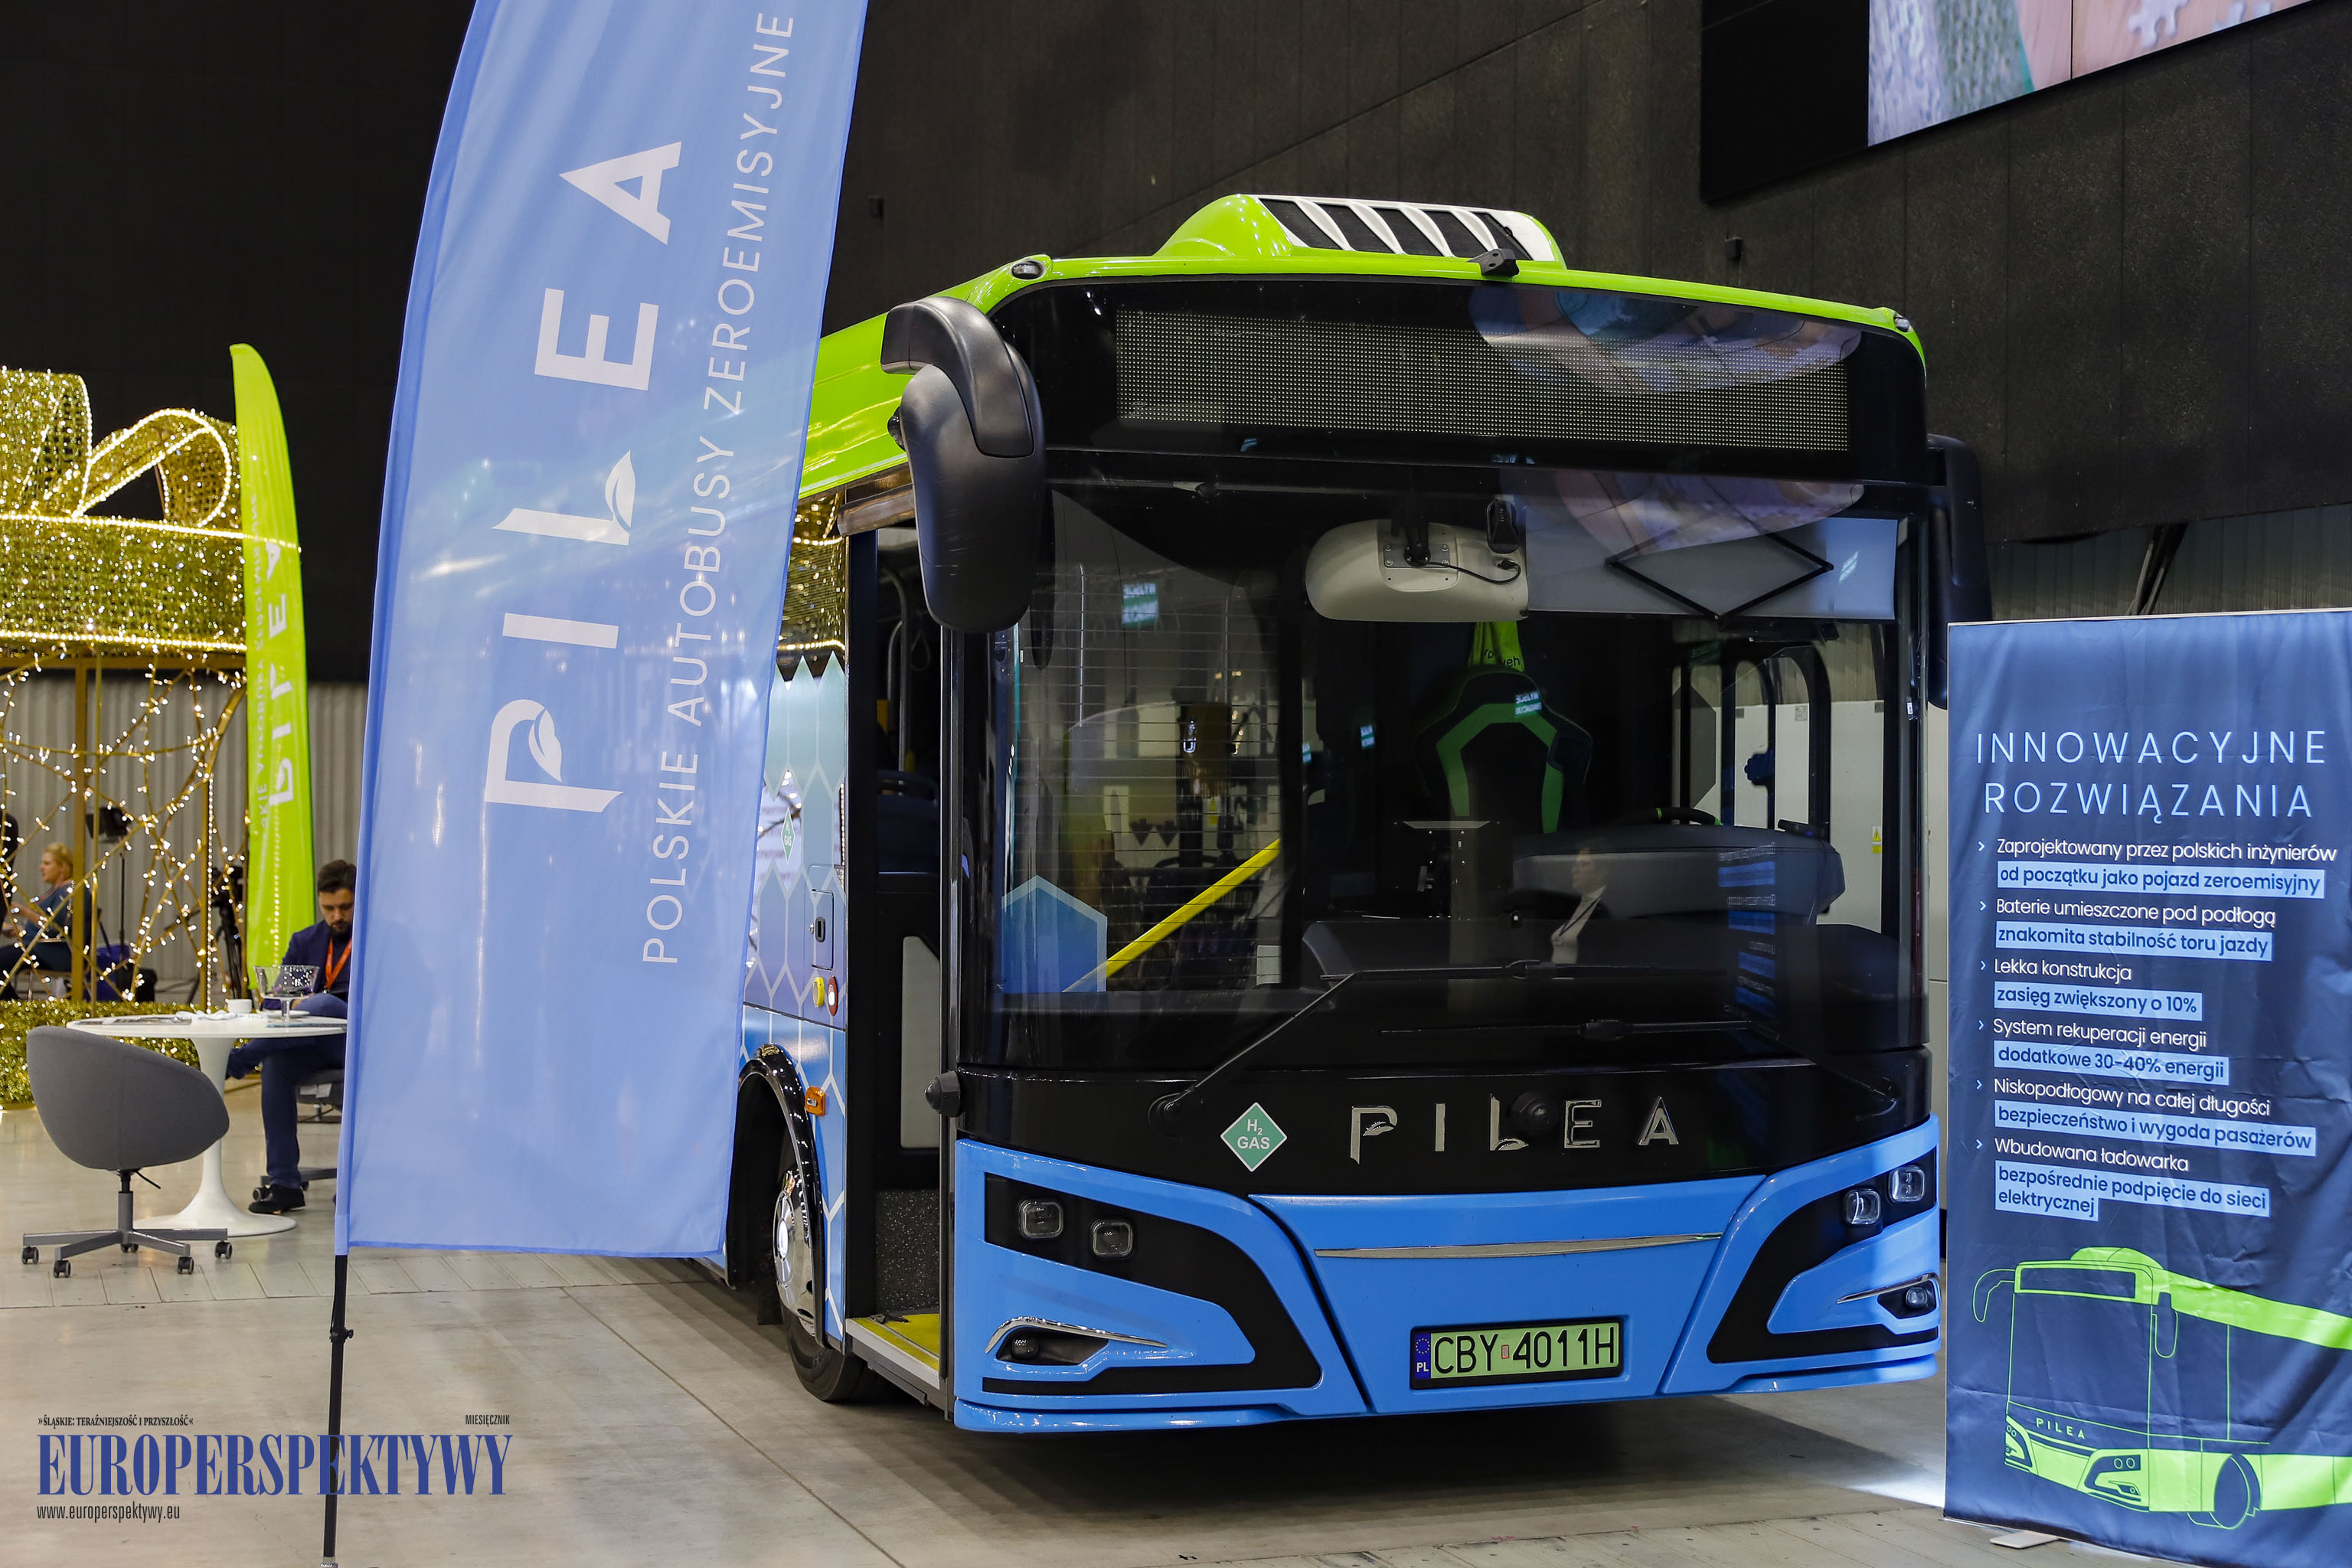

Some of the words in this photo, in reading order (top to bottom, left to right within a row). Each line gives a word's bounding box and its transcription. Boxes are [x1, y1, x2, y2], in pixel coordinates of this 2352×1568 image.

[704, 13, 793, 414] ZEROEMISYJNE
[485, 142, 681, 812] PILEA
[667, 435, 734, 727] AUTOBUSY
[1977, 730, 2325, 763] INNOWACYJNE
[1984, 782, 2312, 824] ROZWIĄZANIA
[642, 750, 699, 963] POLSKIE
[1997, 838, 2122, 862] Zaprojektowany
[2126, 844, 2167, 859] przez
[2172, 843, 2242, 861] polskich
[2247, 843, 2337, 864] inżynierów
[2001, 868, 2018, 881] od
[2024, 868, 2098, 890] początku
[2102, 871, 2138, 889] jako
[2143, 871, 2200, 890] pojazd
[2204, 874, 2321, 895] zeroemisyjny
[1997, 900, 2050, 915] Baterie
[2054, 903, 2158, 920] umieszczone
[2162, 905, 2196, 924] pod
[2201, 905, 2275, 927] podłogą
[1998, 929, 2085, 944] znakomita
[2089, 931, 2176, 949] stabilność
[2181, 936, 2215, 951] toru
[2220, 936, 2268, 957] jazdy
[1994, 959, 2037, 975] Lekka
[2042, 961, 2131, 982] konstrukcja
[1998, 988, 2050, 1008] zasięg
[2054, 990, 2147, 1012] zwiększony
[2151, 998, 2162, 1010] o
[2167, 996, 2197, 1012] 10%
[1994, 1019, 2052, 1037] System
[2056, 1024, 2145, 1048] rekuperacji
[2150, 1031, 2207, 1051] energii
[1998, 1048, 2091, 1067] dodatkowe
[2164, 1060, 2223, 1081] energii
[1994, 1079, 2123, 1107] Niskopodłogowy
[2128, 1093, 2150, 1106] na
[2155, 1093, 2195, 1114] całej
[2200, 1096, 2270, 1117] długości
[1237, 1136, 1270, 1149] GAS
[1350, 1093, 1678, 1165] PILEA
[1998, 1106, 2128, 1132] bezpieczeństwo
[2131, 1118, 2135, 1132] i
[2140, 1120, 2210, 1142] wygoda
[2214, 1126, 2311, 1149] pasażerów
[1995, 1138, 2097, 1162] Wbudowana
[2102, 1148, 2189, 1171] ładowarka
[1999, 1167, 2108, 1192] bezpośrednie
[2112, 1179, 2196, 1203] podpięcie
[2200, 1187, 2222, 1204] do
[2227, 1191, 2265, 1209] sieci
[1999, 1191, 2094, 1217] elektrycznej
[1435, 1333, 1498, 1374] CBY
[1513, 1327, 1615, 1368] 4011H
[1416, 1362, 1429, 1374] PL
[2037, 1418, 2085, 1439] PILEA
